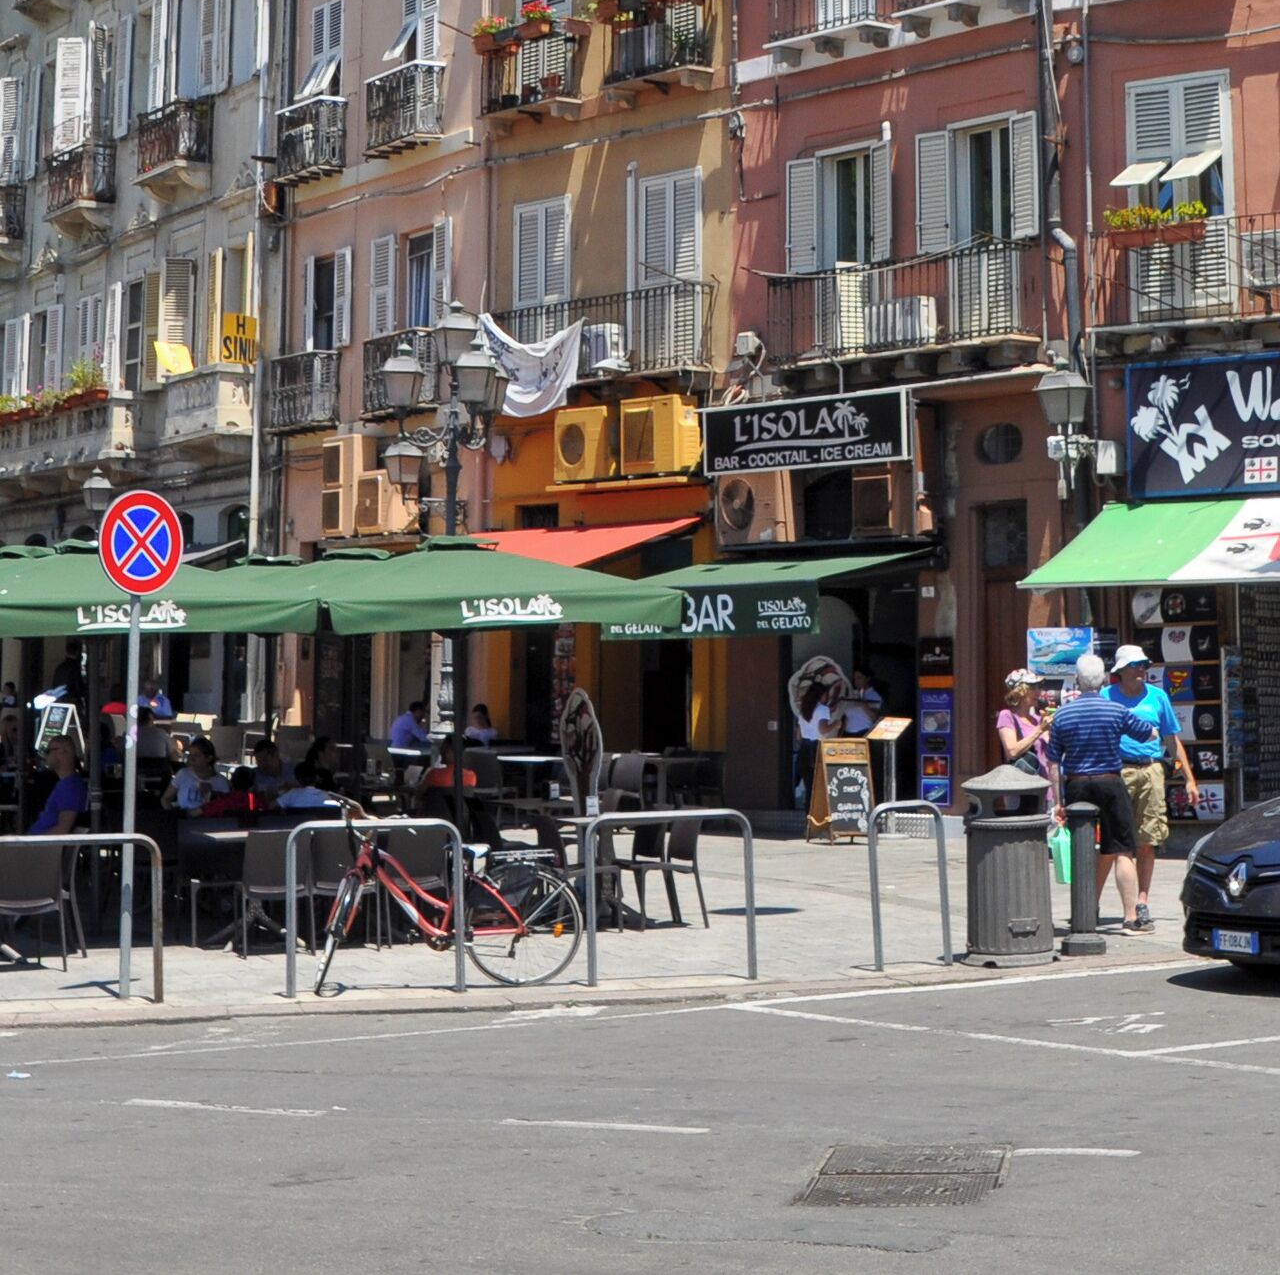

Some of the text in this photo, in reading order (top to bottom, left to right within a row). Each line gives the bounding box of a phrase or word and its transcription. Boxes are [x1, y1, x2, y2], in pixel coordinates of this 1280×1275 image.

[733, 406, 836, 443] L'ISOLA
[714, 455, 740, 470] BAR
[748, 449, 811, 467] COCKTAIL
[820, 446, 843, 461] ICE
[844, 441, 893, 458] CREAM
[460, 597, 542, 618] L'ISOLA
[681, 593, 736, 633] BAR
[757, 599, 795, 613] L'ISOLA
[771, 615, 812, 629] GELATO
